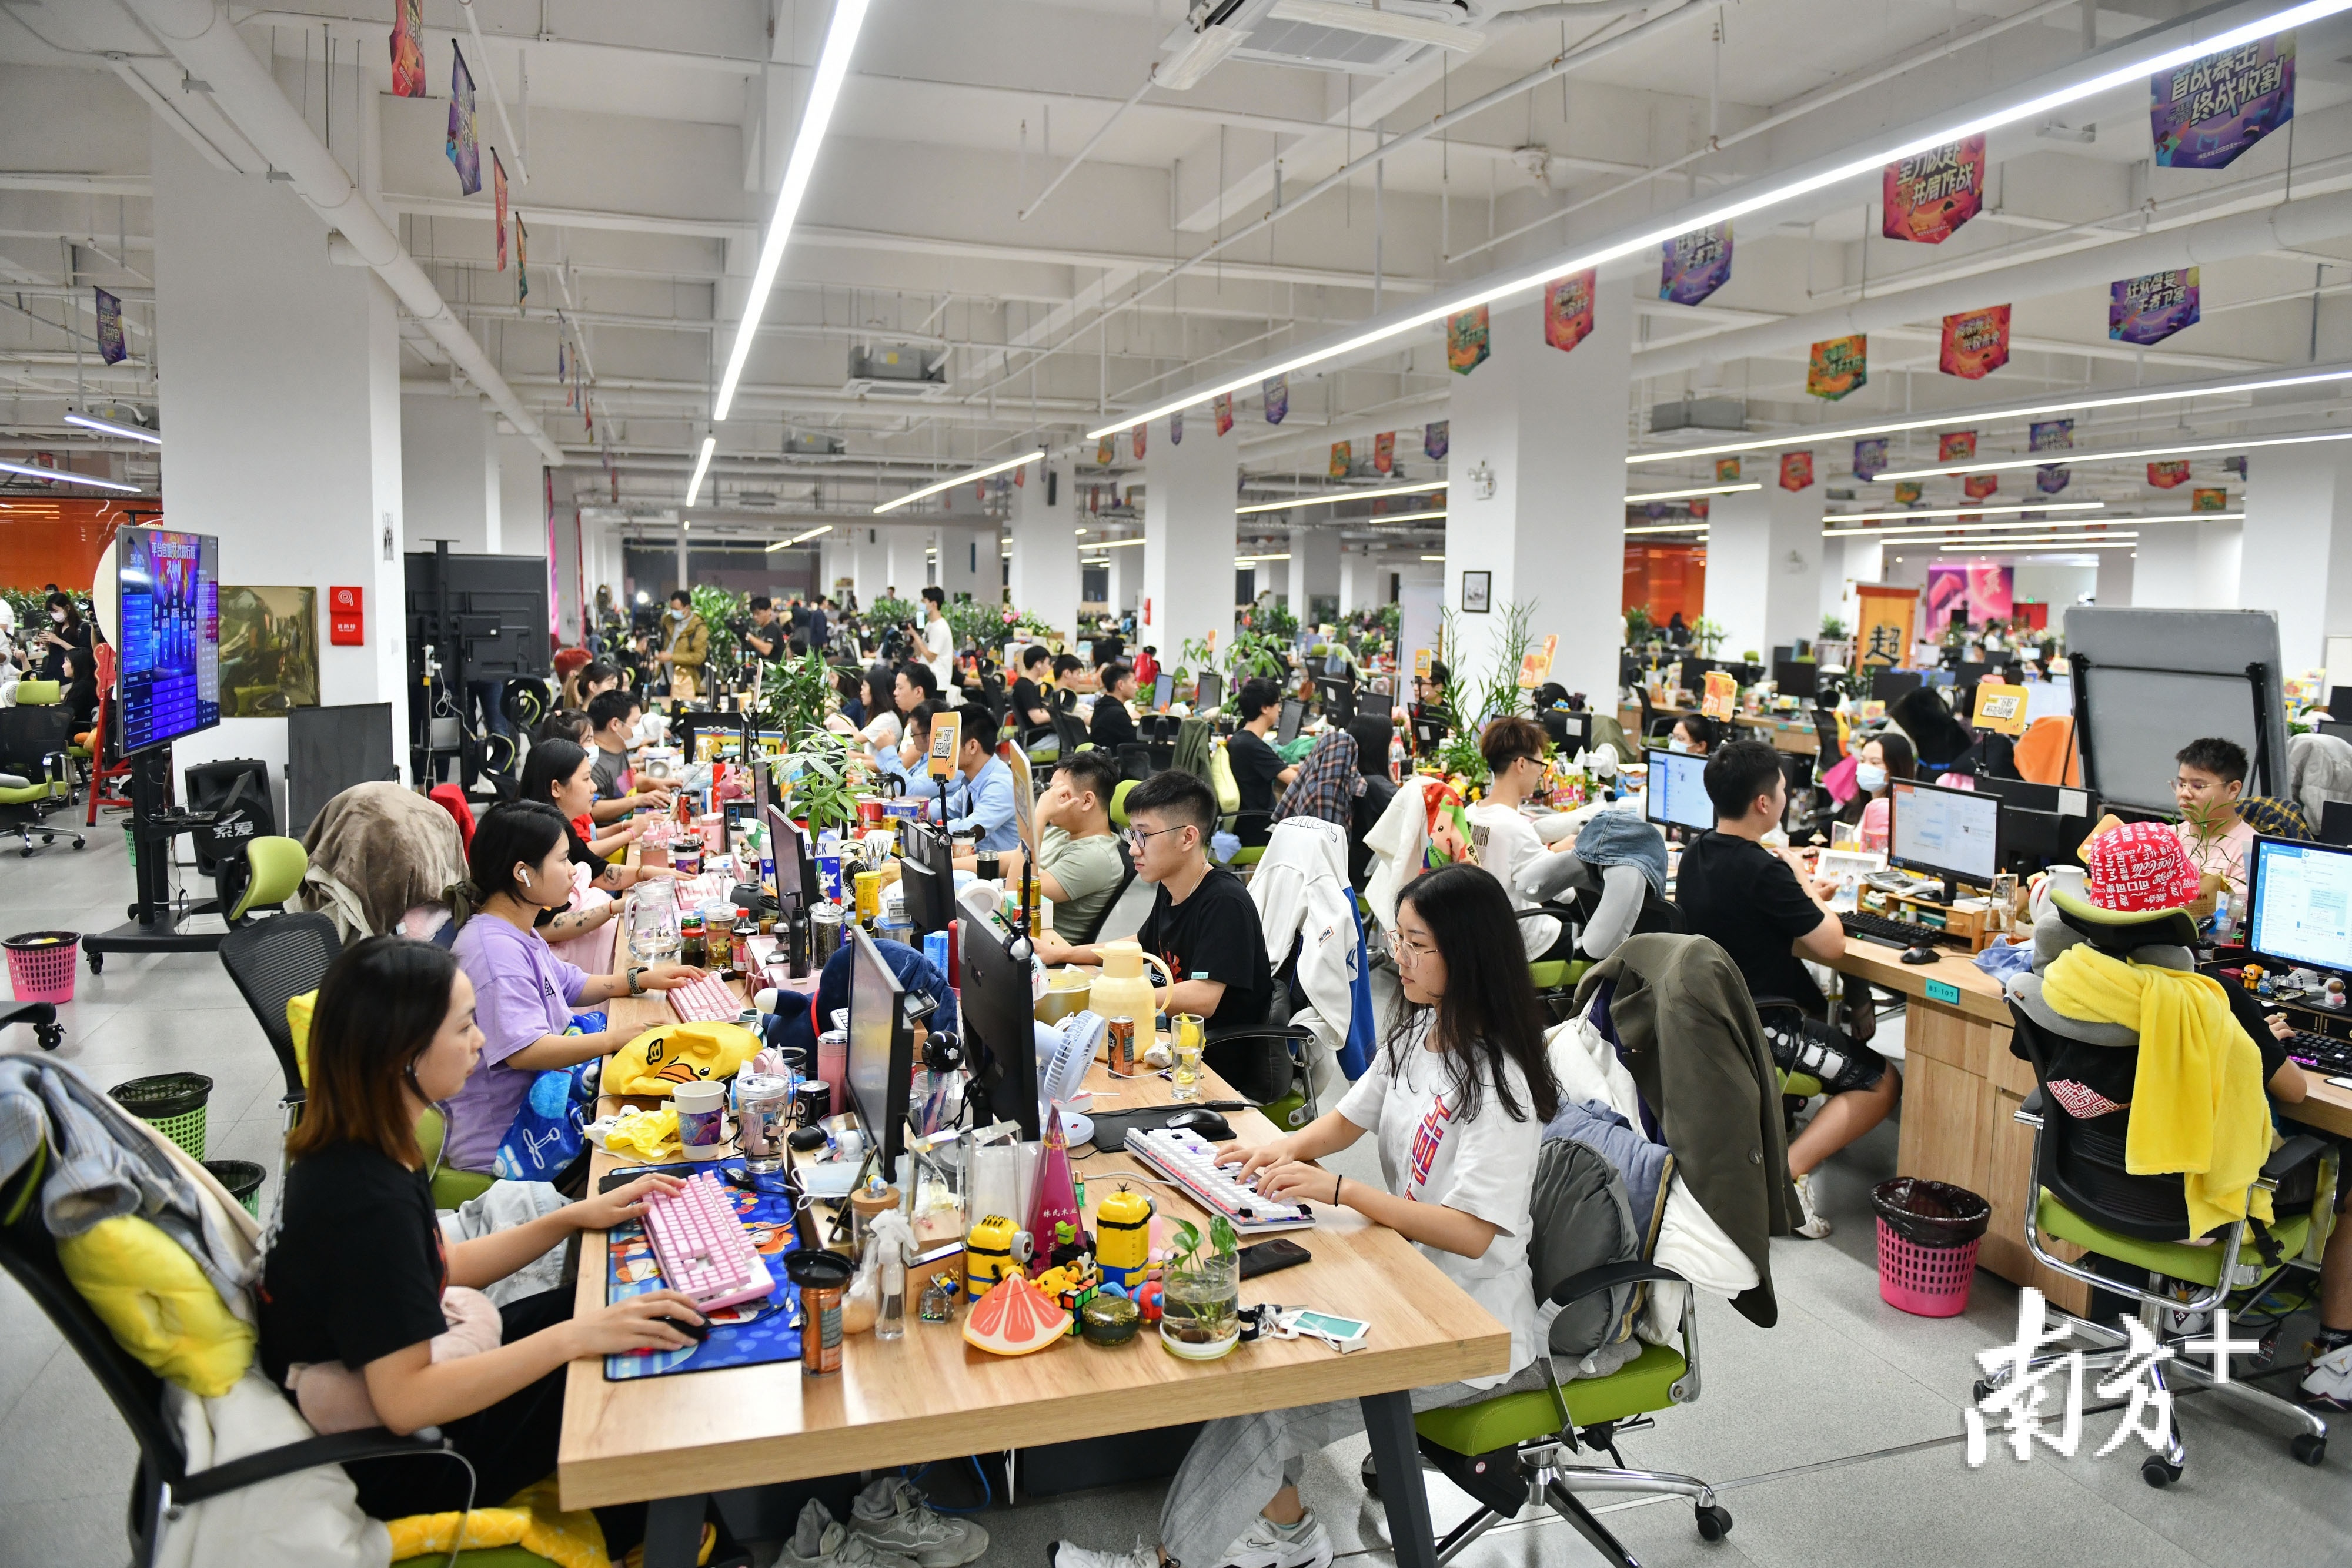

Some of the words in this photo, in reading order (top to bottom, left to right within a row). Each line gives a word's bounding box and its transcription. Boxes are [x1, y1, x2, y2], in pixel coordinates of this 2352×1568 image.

[2189, 55, 2285, 128] 终战收割
[1864, 624, 1902, 666] 超
[805, 842, 827, 856] PCK
[1319, 929, 1331, 944] PUMA
[1929, 985, 1954, 998] B3-107
[2176, 1312, 2186, 1322] 23
